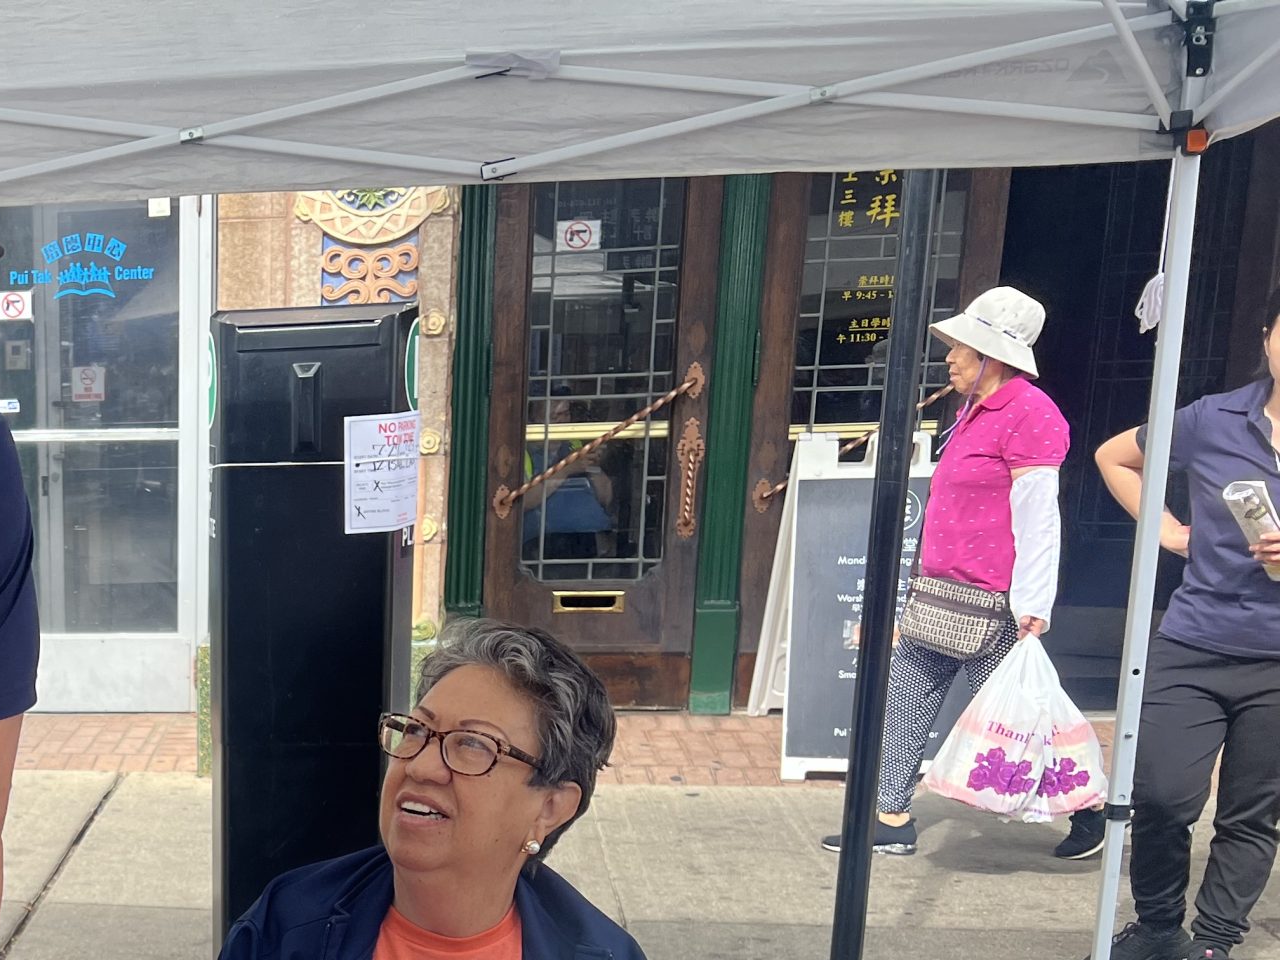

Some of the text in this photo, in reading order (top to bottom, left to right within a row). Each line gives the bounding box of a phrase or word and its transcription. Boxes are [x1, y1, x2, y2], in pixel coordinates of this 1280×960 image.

[10, 266, 154, 285] Pui Tak Center
[856, 290, 877, 300] 9:45
[850, 334, 876, 343] 11:30
[378, 422, 397, 434] NO
